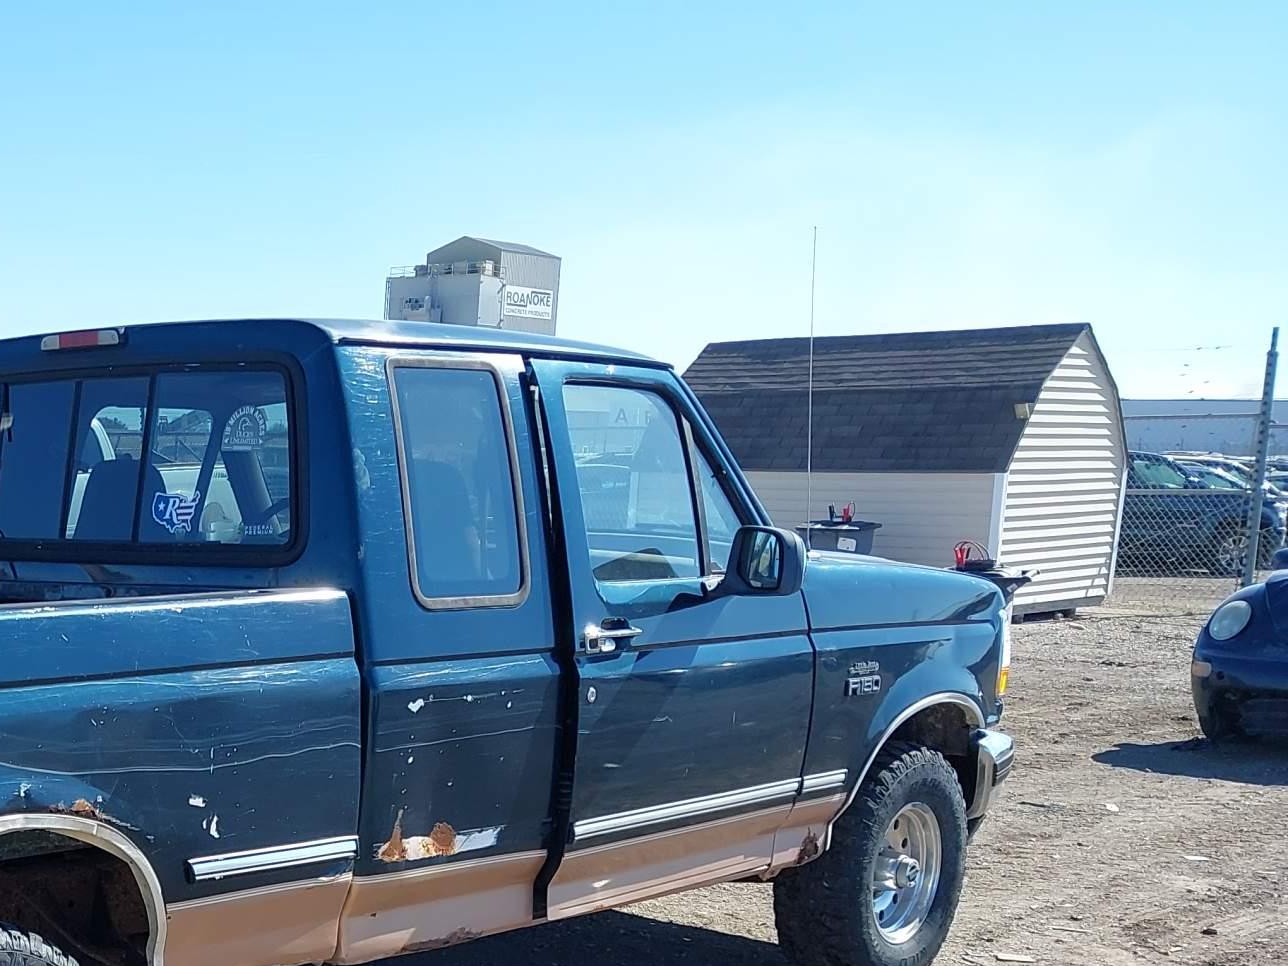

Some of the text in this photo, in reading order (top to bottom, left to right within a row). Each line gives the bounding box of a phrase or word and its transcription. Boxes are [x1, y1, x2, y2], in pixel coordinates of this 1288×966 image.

[506, 291, 551, 307] ROANOKE
[505, 307, 550, 318] CONCRETE PRODUCTS
